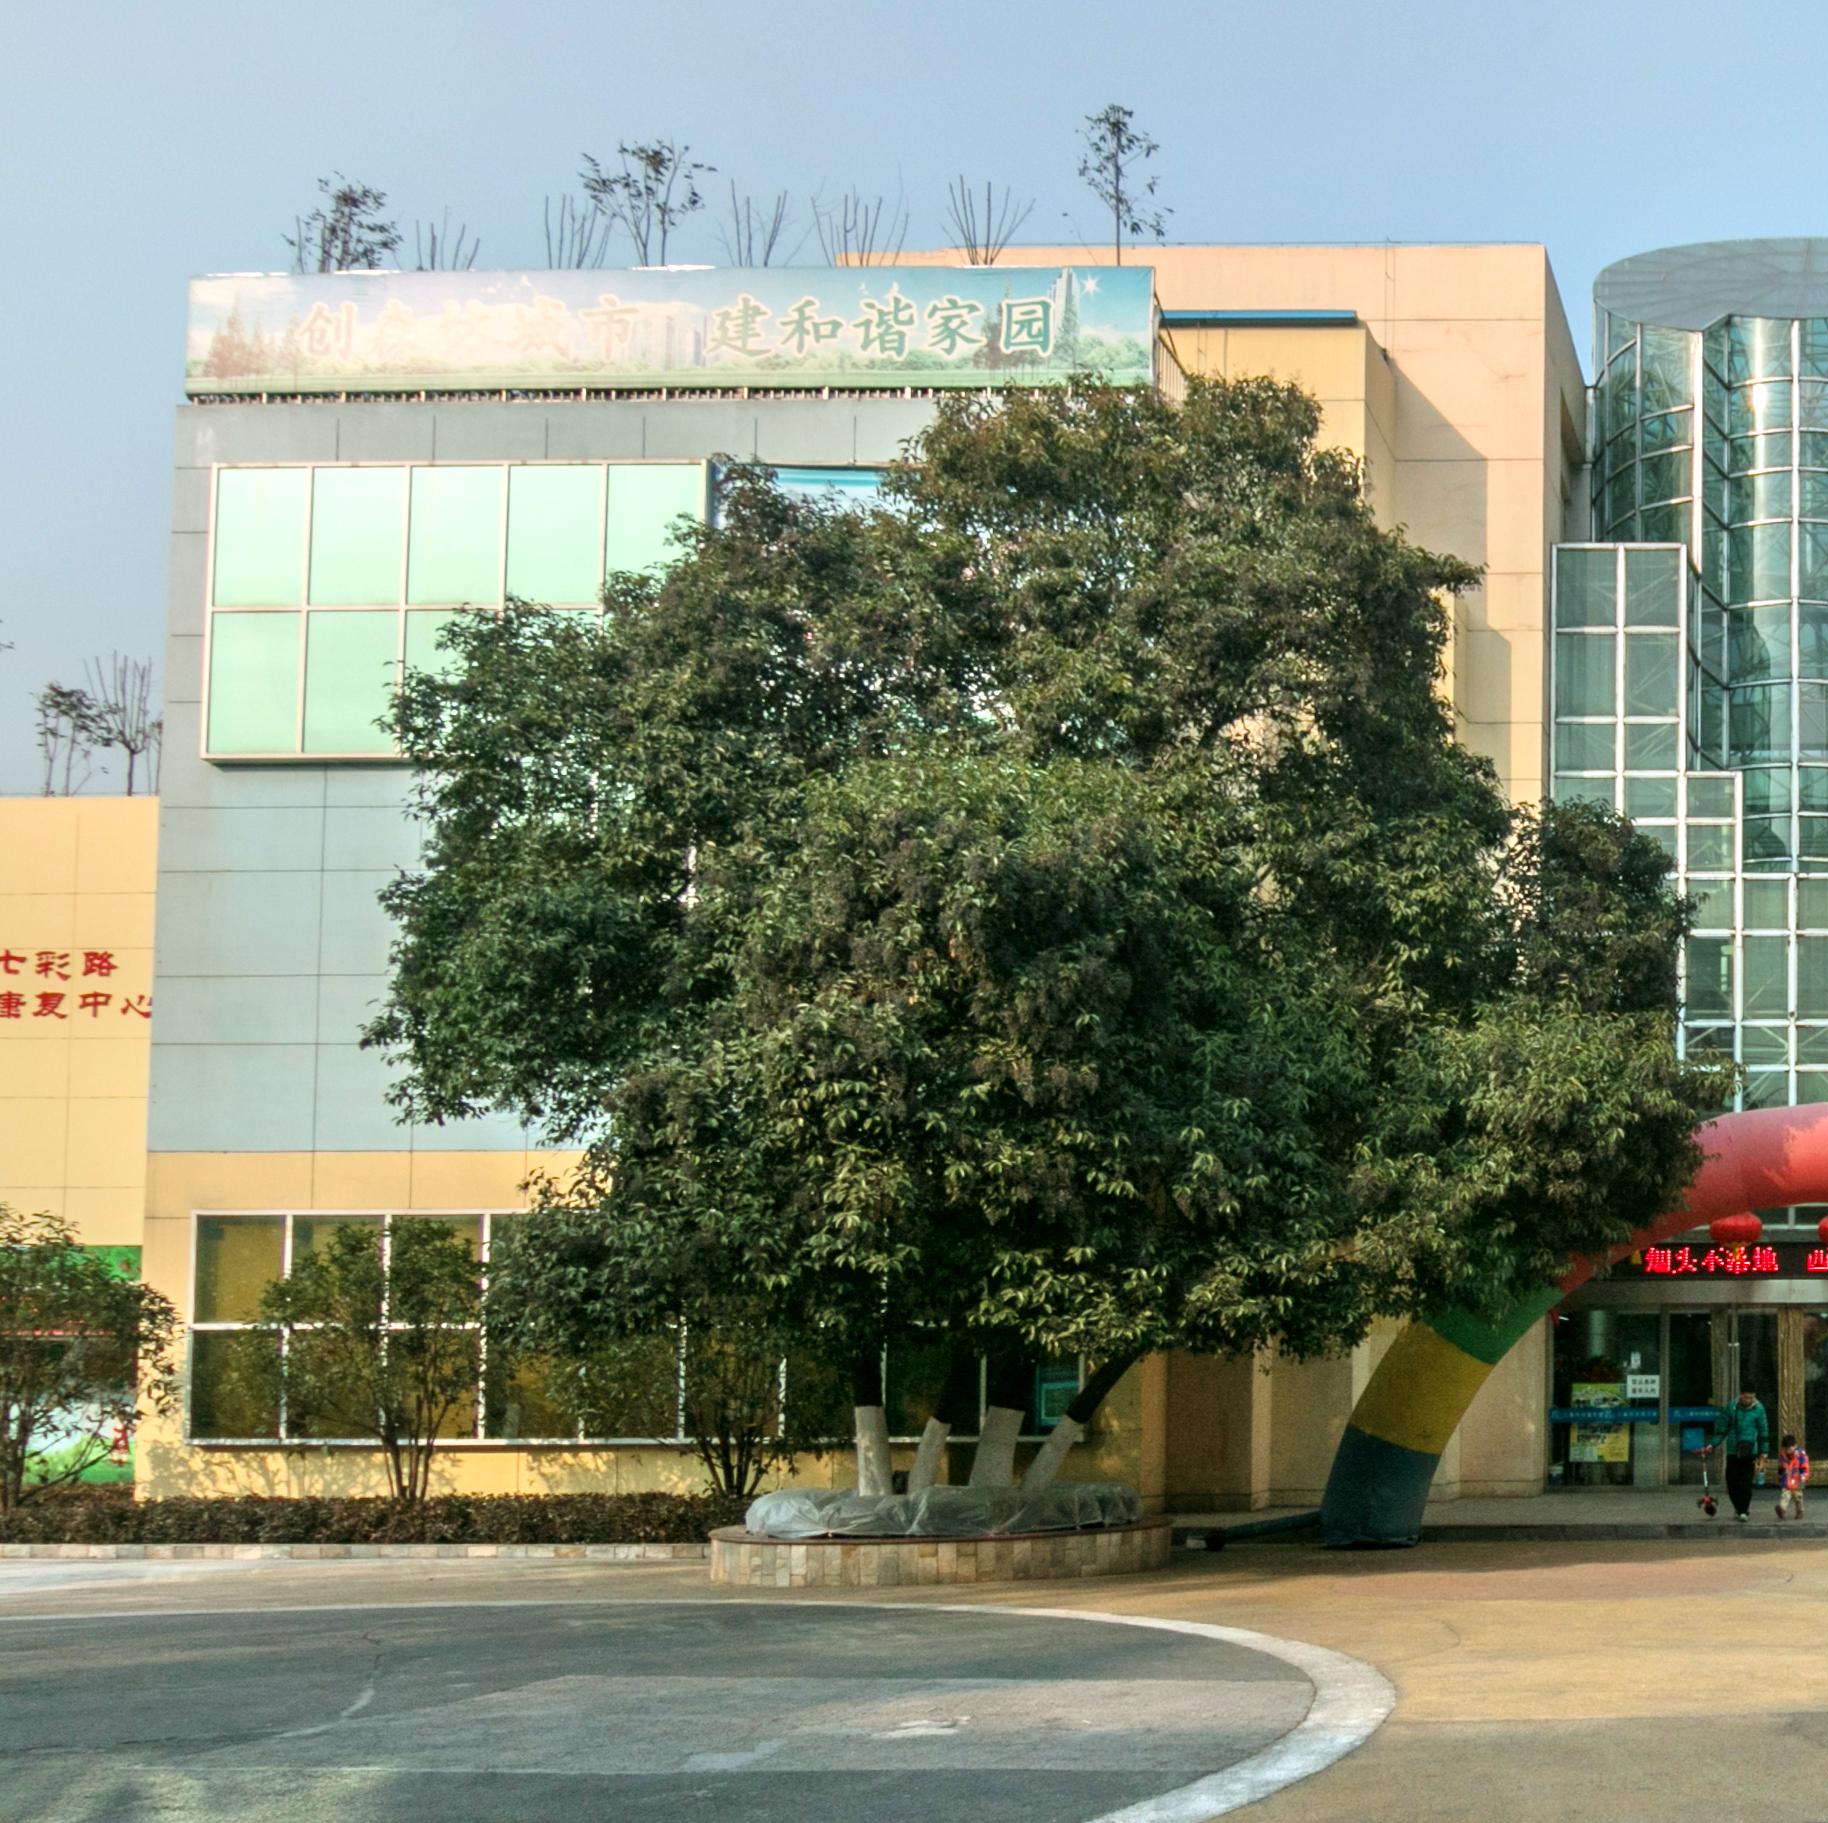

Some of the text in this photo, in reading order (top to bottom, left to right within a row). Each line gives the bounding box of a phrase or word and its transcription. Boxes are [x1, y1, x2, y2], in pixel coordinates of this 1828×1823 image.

[301, 296, 1054, 360] 创森城市 建和谐家园
[0, 949, 118, 981] 七彩路
[0, 991, 152, 1019] 康复中心
